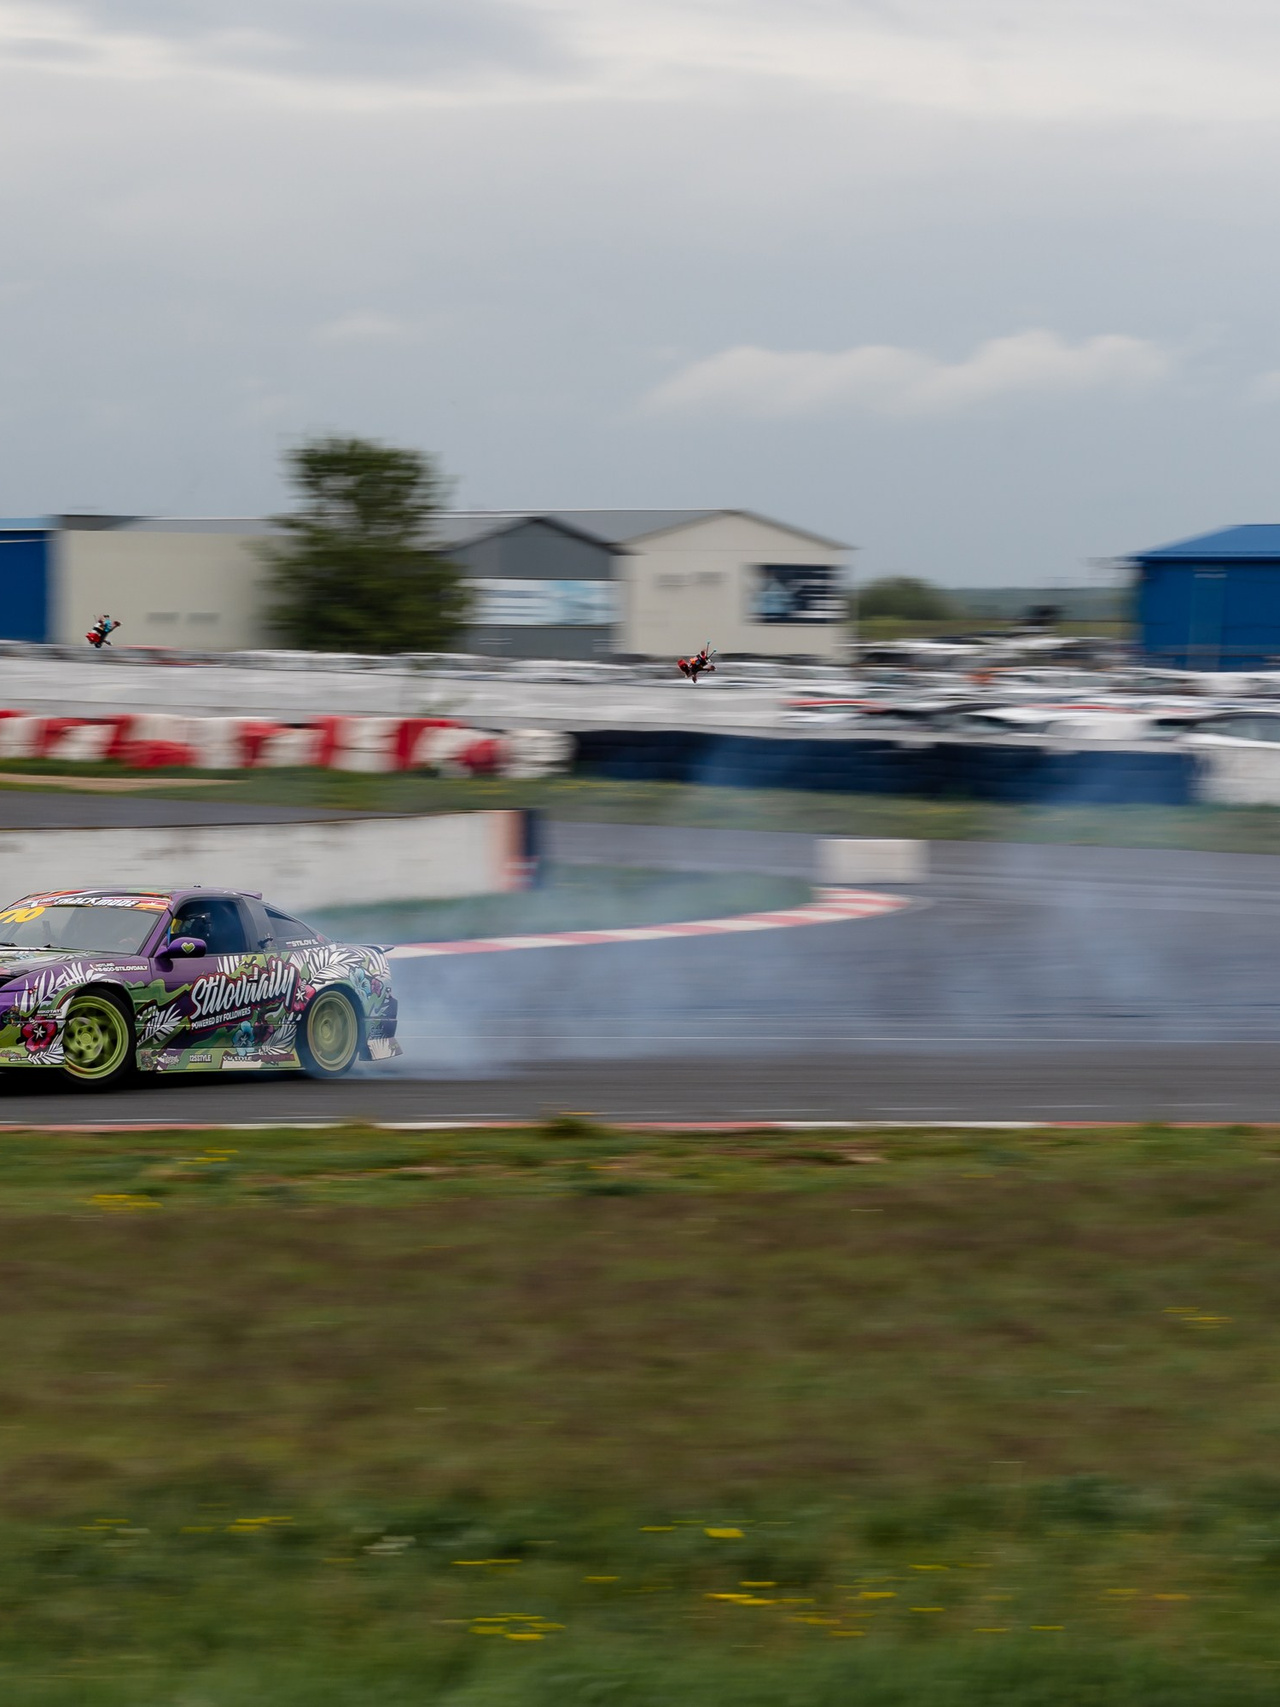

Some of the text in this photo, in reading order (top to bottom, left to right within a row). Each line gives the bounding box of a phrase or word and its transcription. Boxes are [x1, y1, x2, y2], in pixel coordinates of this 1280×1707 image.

[191, 1006, 251, 1030] POWERED BY FOLLOWERS
